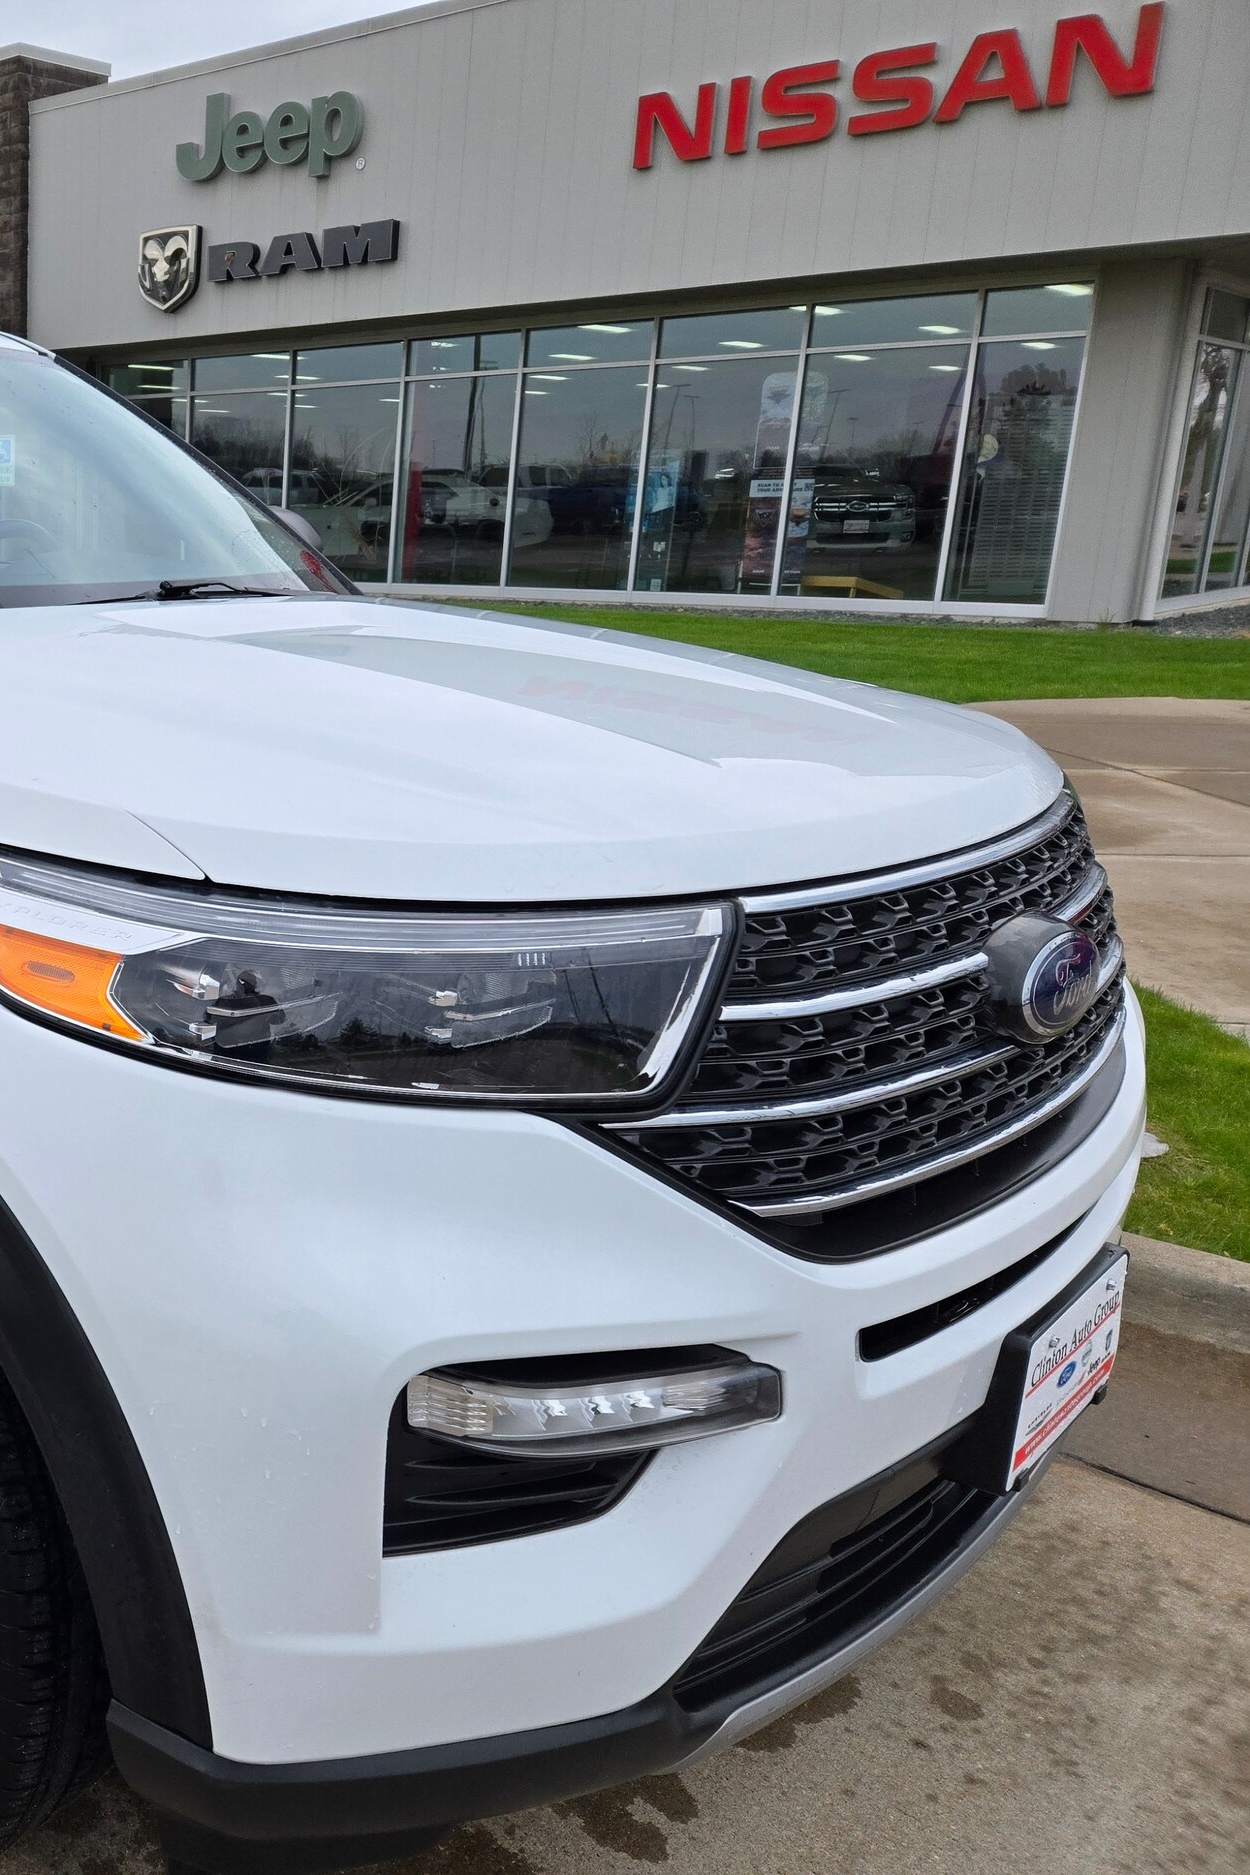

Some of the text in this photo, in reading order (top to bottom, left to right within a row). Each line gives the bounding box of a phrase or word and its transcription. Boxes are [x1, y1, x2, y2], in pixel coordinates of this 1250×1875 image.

[632, 2, 1166, 170] NISSAN
[175, 90, 365, 182] Jeep
[206, 218, 401, 282] RAM
[1053, 952, 1093, 1016] Ford
[1031, 1290, 1120, 1388] Clinton Auto Group
